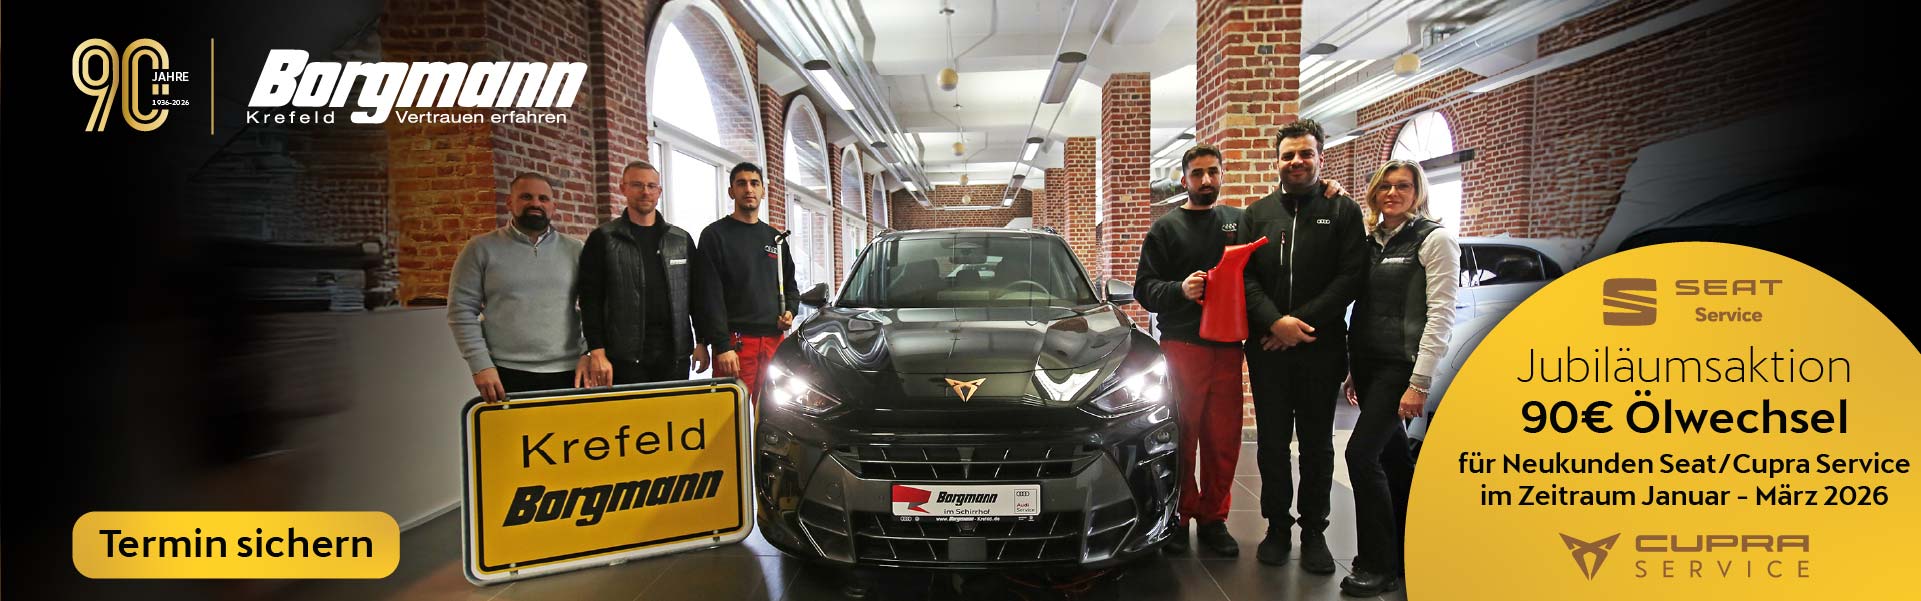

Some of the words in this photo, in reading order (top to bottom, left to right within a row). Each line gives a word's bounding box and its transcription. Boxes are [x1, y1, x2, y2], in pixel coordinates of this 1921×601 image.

[522, 418, 705, 468] Krefeld
[502, 470, 723, 527] Borgmann
[936, 491, 998, 506] Borgmann
